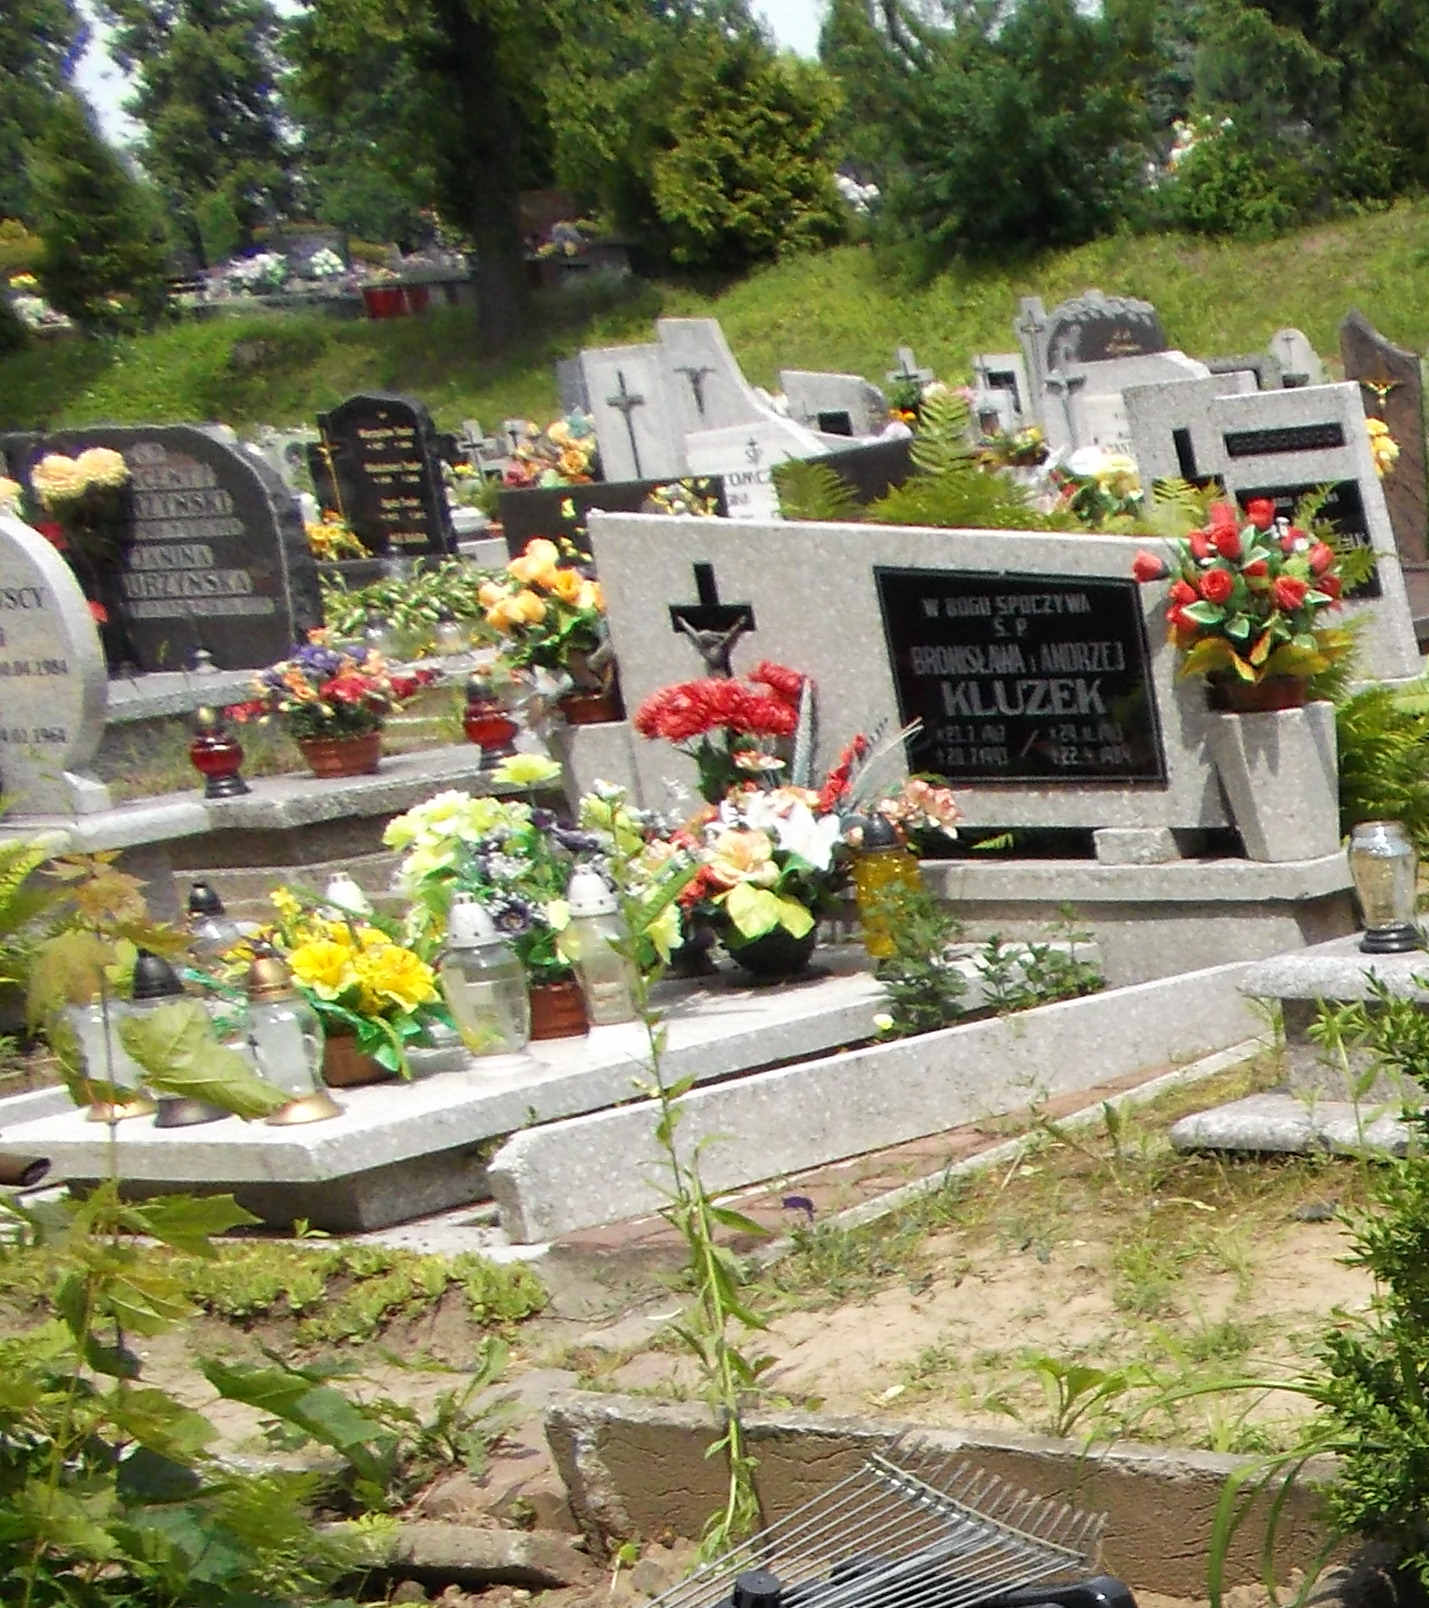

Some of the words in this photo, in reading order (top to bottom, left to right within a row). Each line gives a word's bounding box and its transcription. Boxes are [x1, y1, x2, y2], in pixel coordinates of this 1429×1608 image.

[994, 592, 1093, 616] SPOCZYWA
[911, 644, 1027, 676] BRONISŁAWA
[1040, 640, 1127, 673] ANDRZEJ
[940, 677, 1109, 718] KLUZEK
